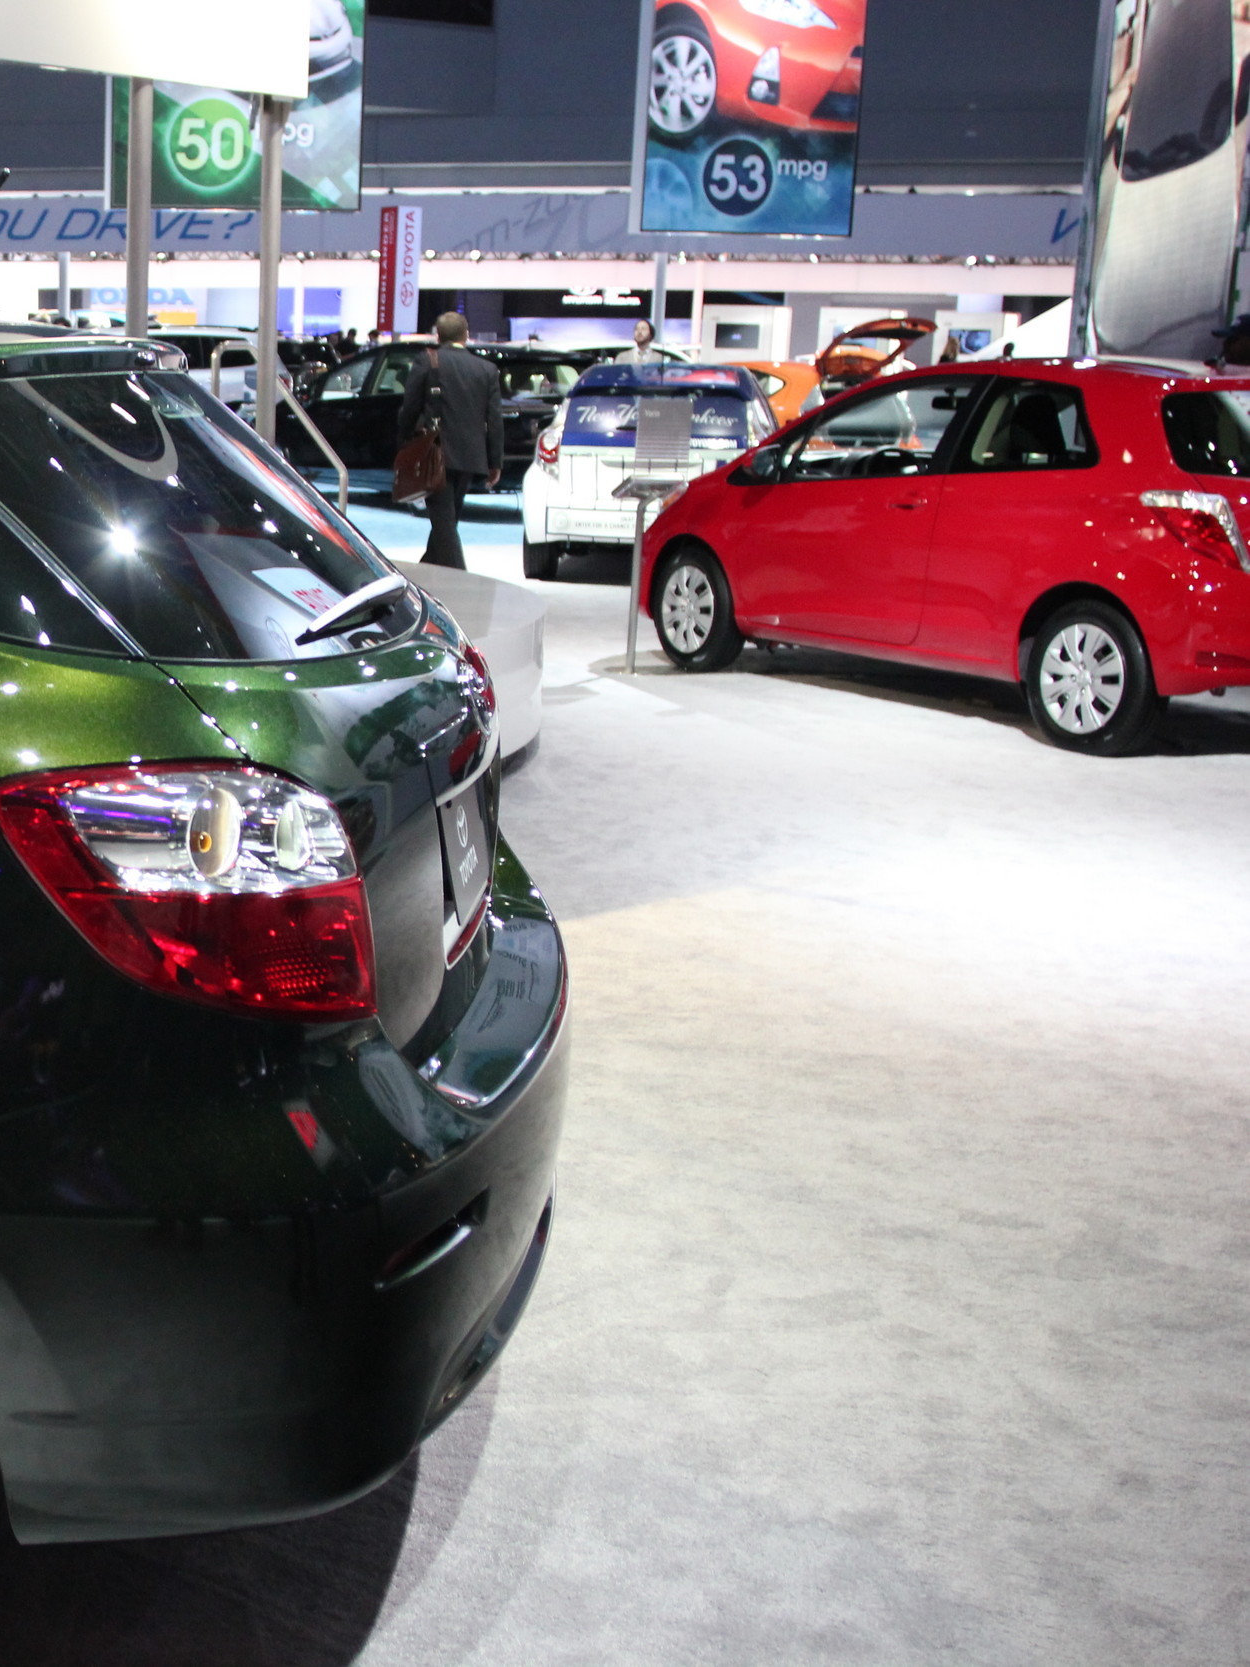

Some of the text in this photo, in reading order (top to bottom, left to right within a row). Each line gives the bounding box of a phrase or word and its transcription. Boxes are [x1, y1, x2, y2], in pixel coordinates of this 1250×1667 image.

[174, 117, 245, 171] 50
[708, 153, 828, 201] 53 mpg
[55, 208, 254, 241] DRVE?
[403, 210, 415, 277] TOYOTA
[691, 407, 734, 426] nkees
[459, 844, 479, 888] TOYOTA
